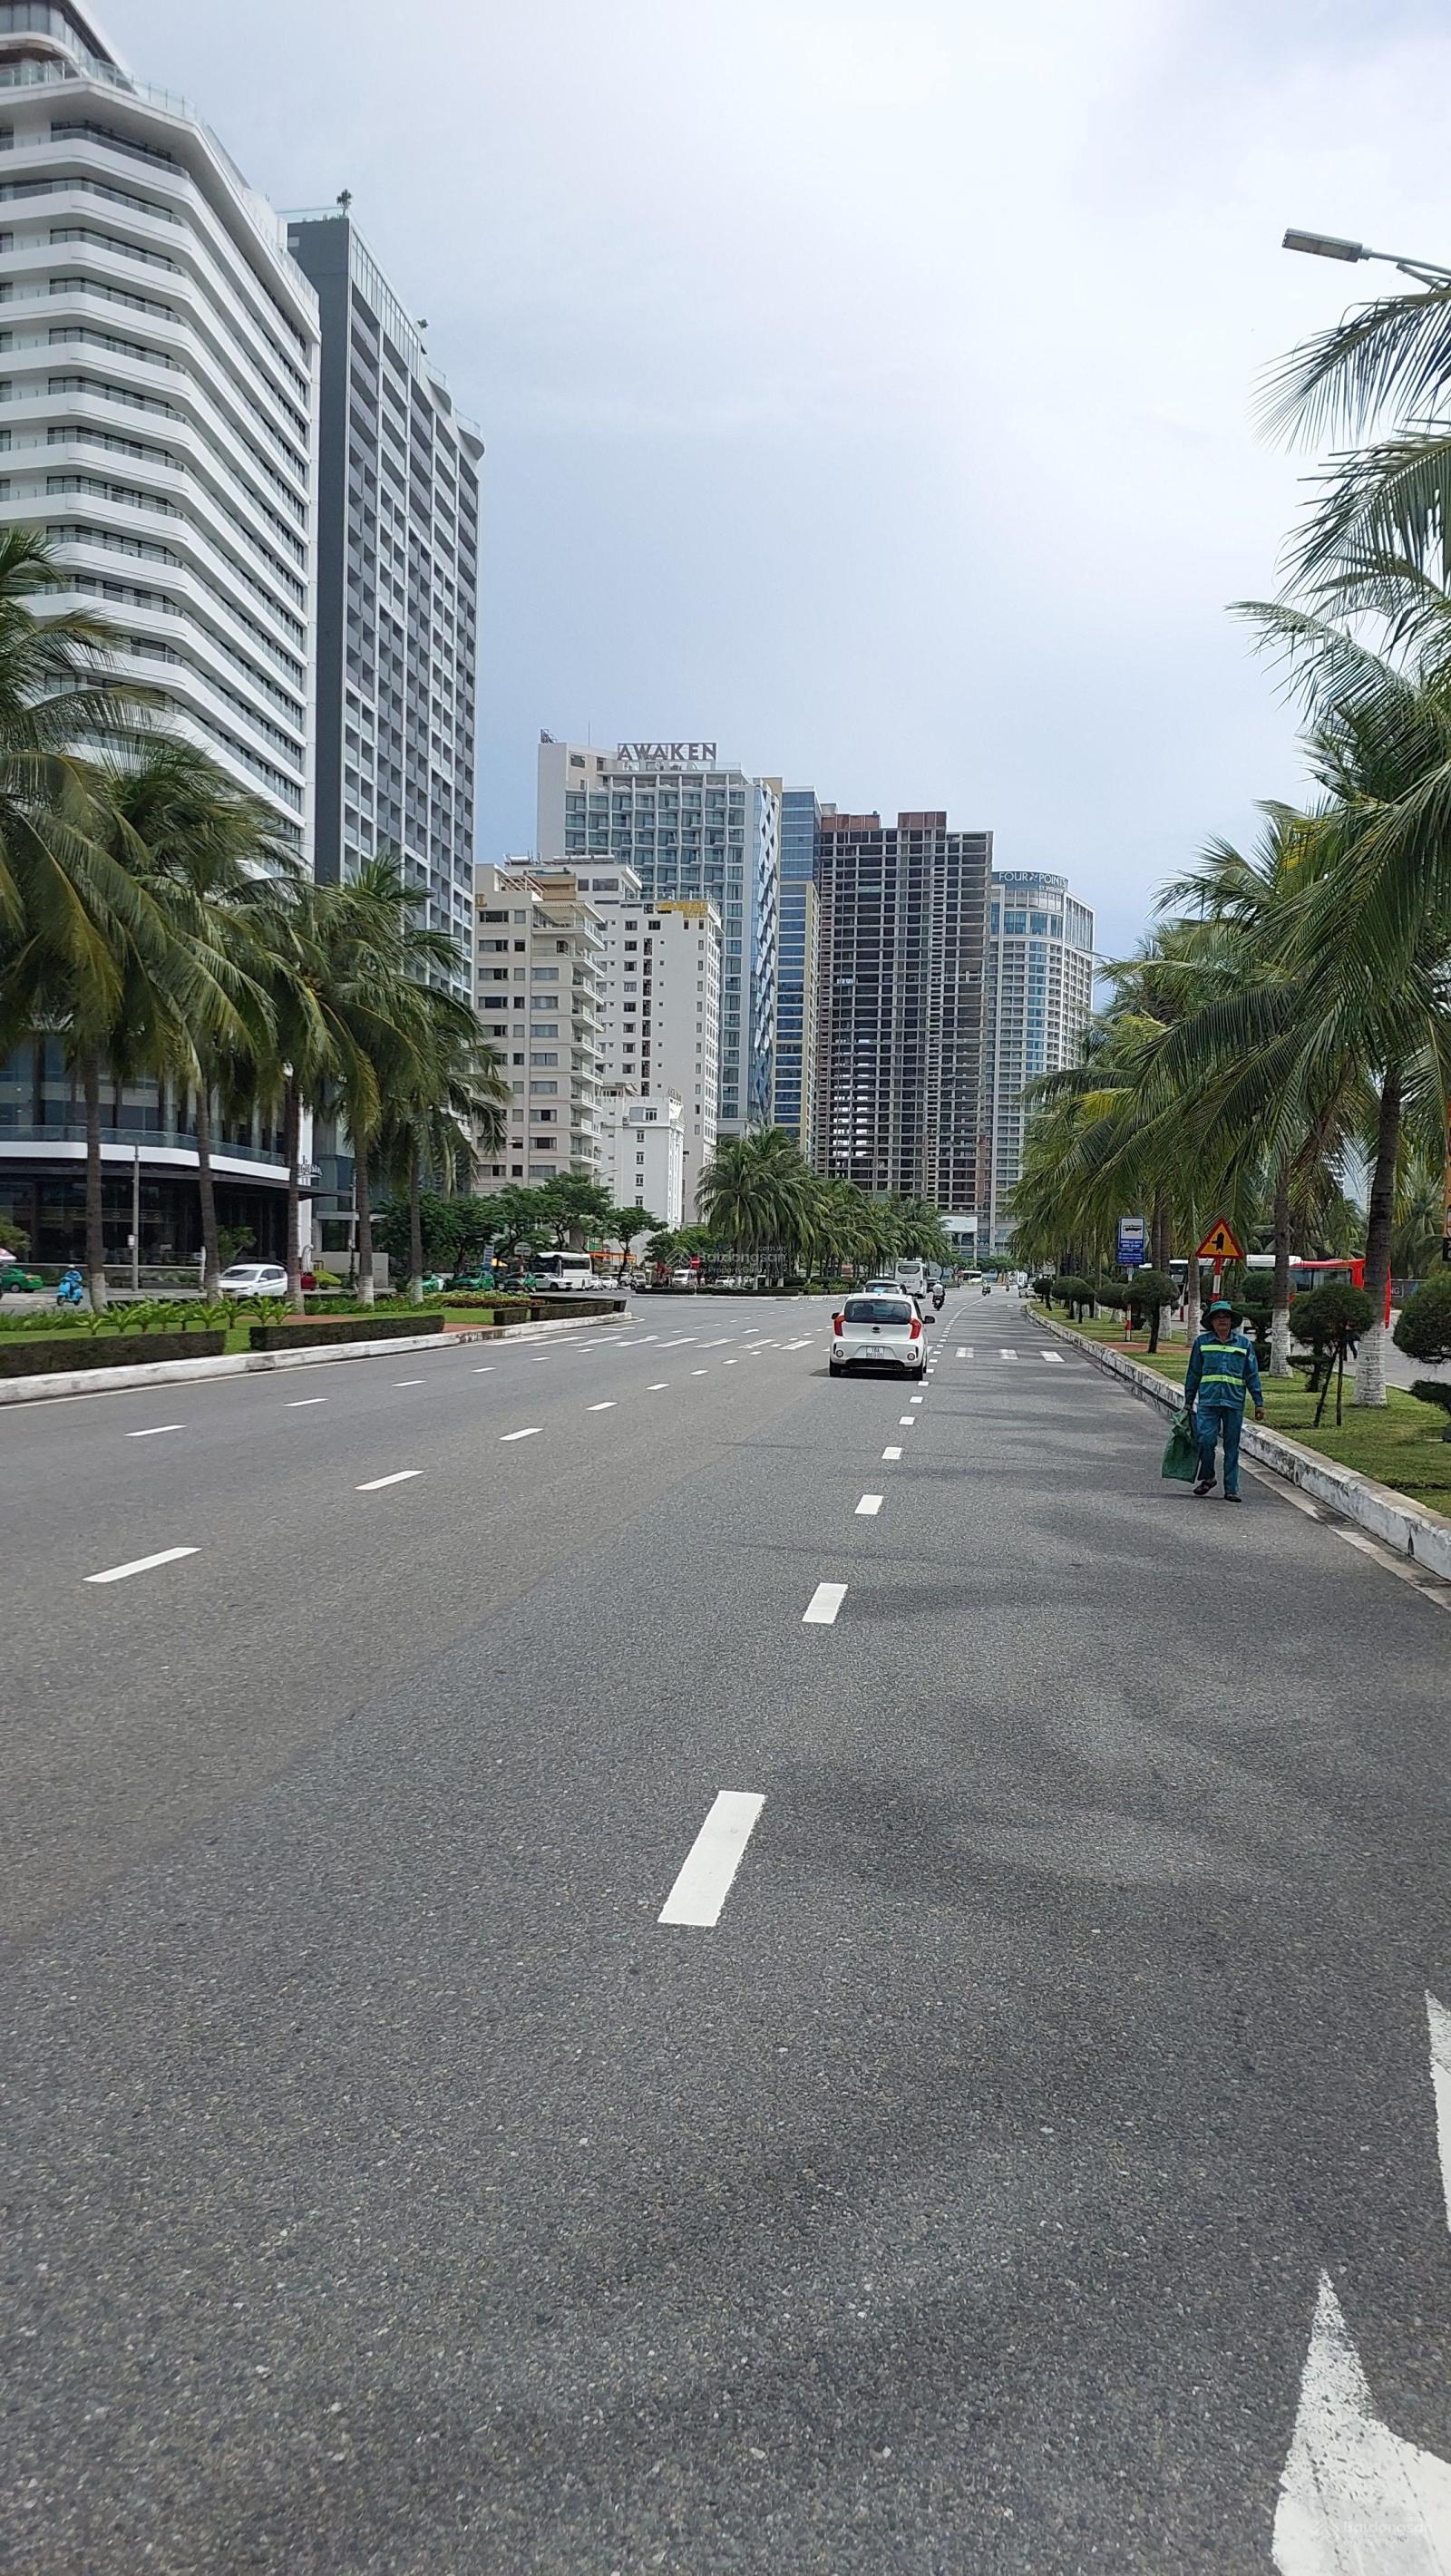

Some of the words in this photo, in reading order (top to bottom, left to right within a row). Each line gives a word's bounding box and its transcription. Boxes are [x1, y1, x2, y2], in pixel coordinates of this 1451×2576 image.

[617, 743, 716, 761] AWAKEN
[998, 871, 1027, 881] FOUR
[1038, 873, 1066, 888] POINTS
